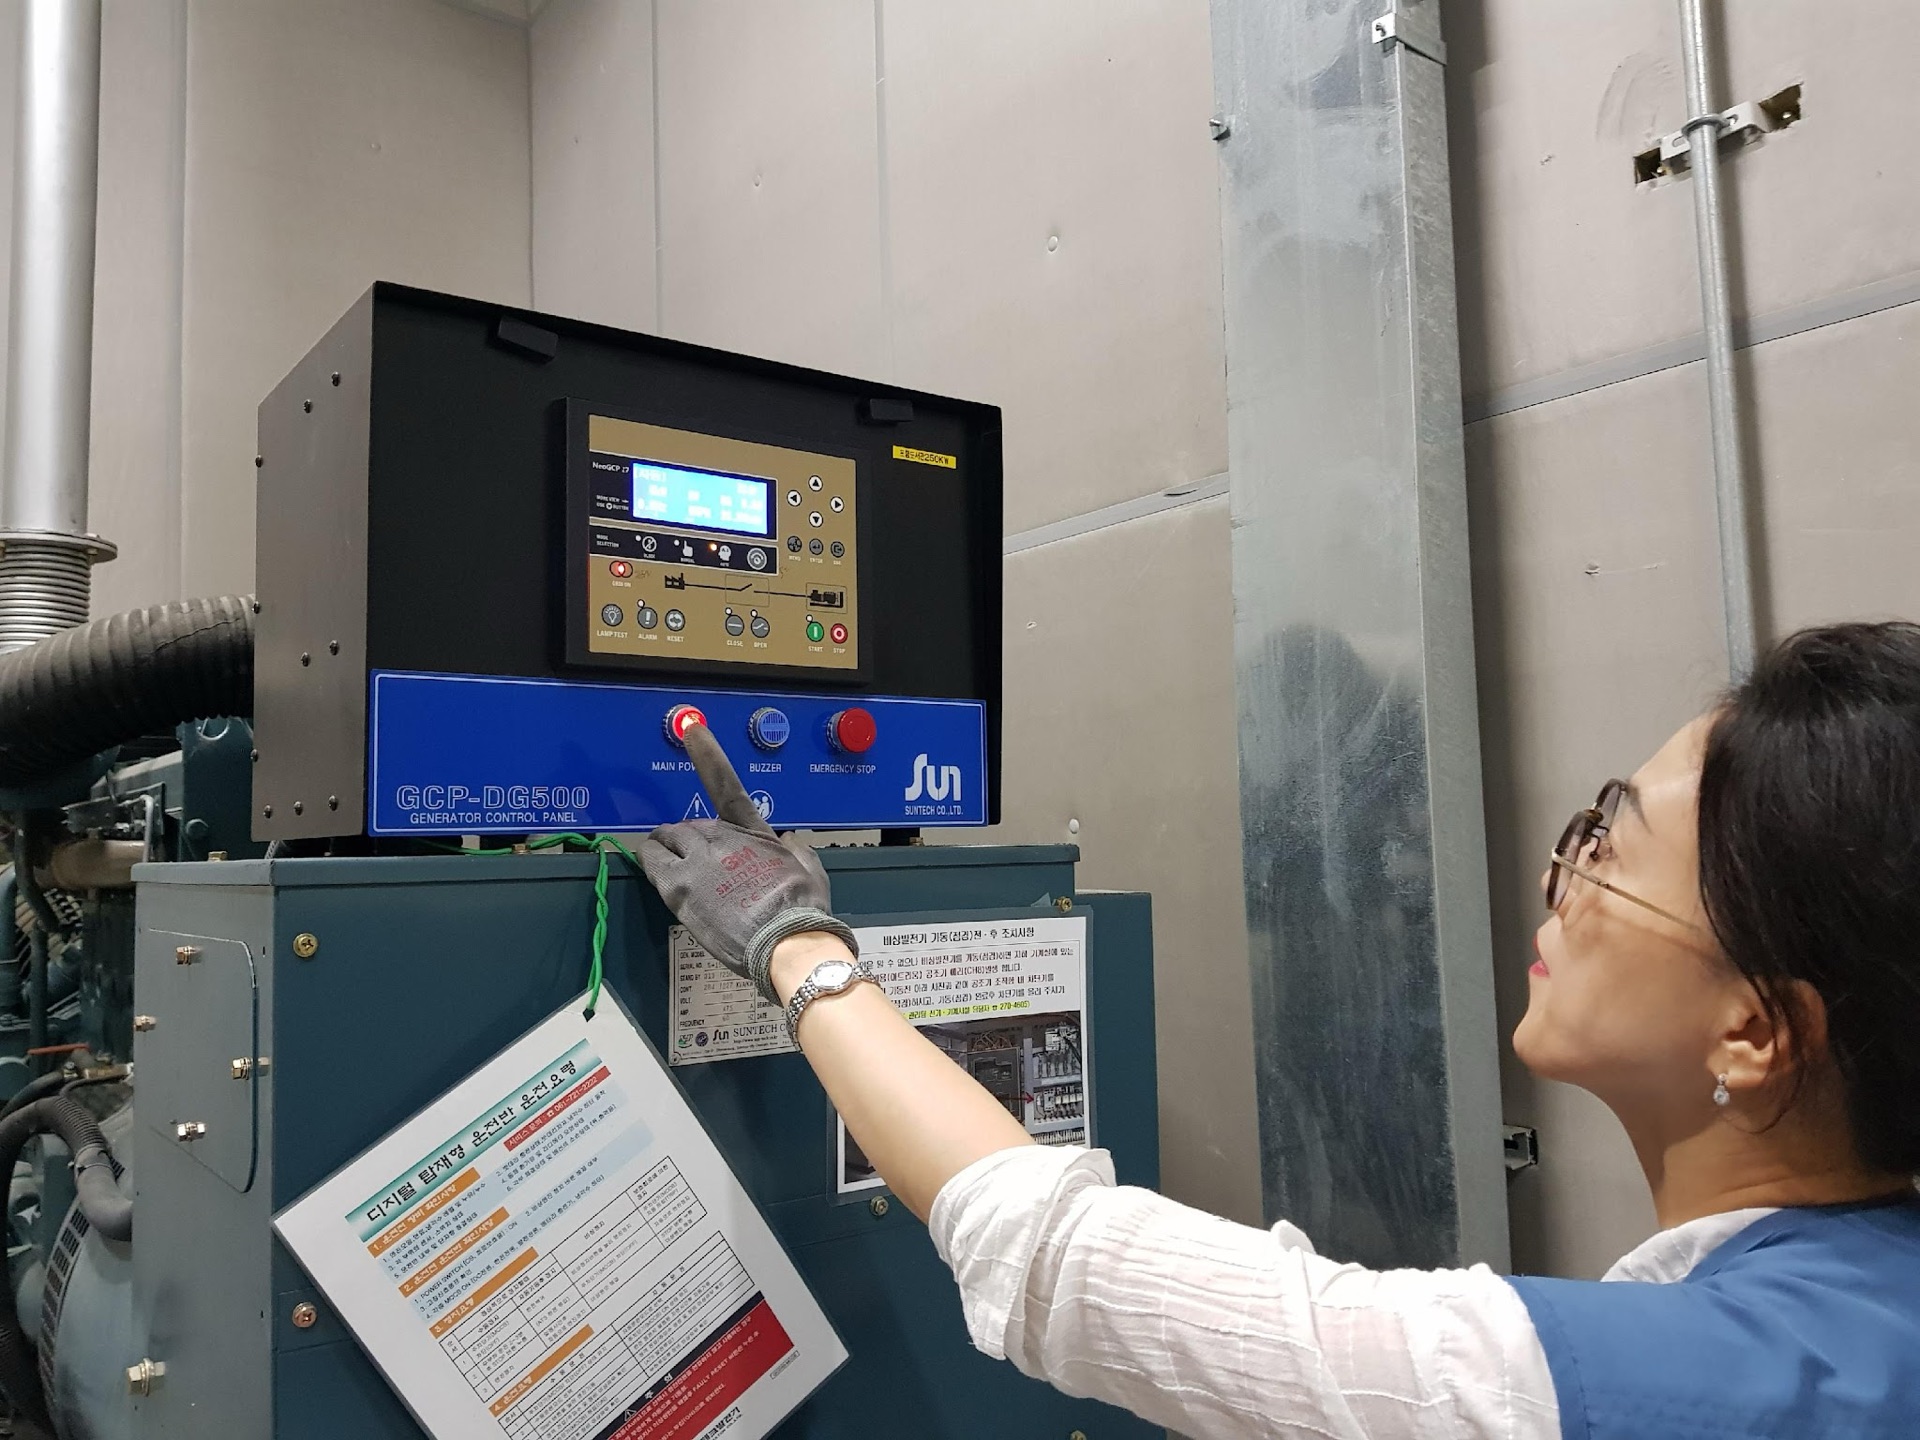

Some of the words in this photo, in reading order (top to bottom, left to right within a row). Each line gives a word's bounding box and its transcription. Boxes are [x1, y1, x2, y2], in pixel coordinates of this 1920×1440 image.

[592, 461, 620, 472] NeoGCP
[596, 630, 614, 638] LAMP
[613, 631, 628, 639] TEST
[638, 633, 658, 641] ALARM
[753, 641, 768, 649] OPEN
[808, 645, 823, 653] START
[651, 761, 676, 771] MAIN
[749, 763, 782, 773] BUZZER
[809, 763, 855, 774] EMERGENCY
[856, 764, 876, 775] STOP
[396, 785, 590, 810] GCP-DG500
[905, 805, 935, 816] SUNTECH
[410, 812, 482, 824] GENERATOR
[485, 812, 539, 824] CONTROL
[543, 812, 578, 823] PANEL
[883, 933, 926, 945] 비상발전기
[1001, 927, 1034, 938] 조치사항
[887, 958, 893, 967] 수
[897, 957, 917, 967] 없으나
[921, 954, 962, 965] 비상발전기를
[926, 968, 946, 978] 공조기
[971, 978, 991, 988] 공조기
[679, 1019, 705, 1028] FREQUENCY
[733, 1024, 778, 1038] SUNTECH
[507, 1128, 529, 1147] 서비스
[528, 1117, 543, 1131] 문의
[365, 1181, 417, 1225] 디지털
[417, 1143, 467, 1186] 탑재형
[468, 1105, 518, 1148] 운전반
[517, 1059, 578, 1111] 운전요령
[424, 1183, 457, 1211] 확인사항
[420, 1280, 442, 1299] POWER
[440, 1262, 464, 1283] SWITCH
[692, 1373, 711, 1392] FAULT
[709, 1358, 728, 1376] RESET
